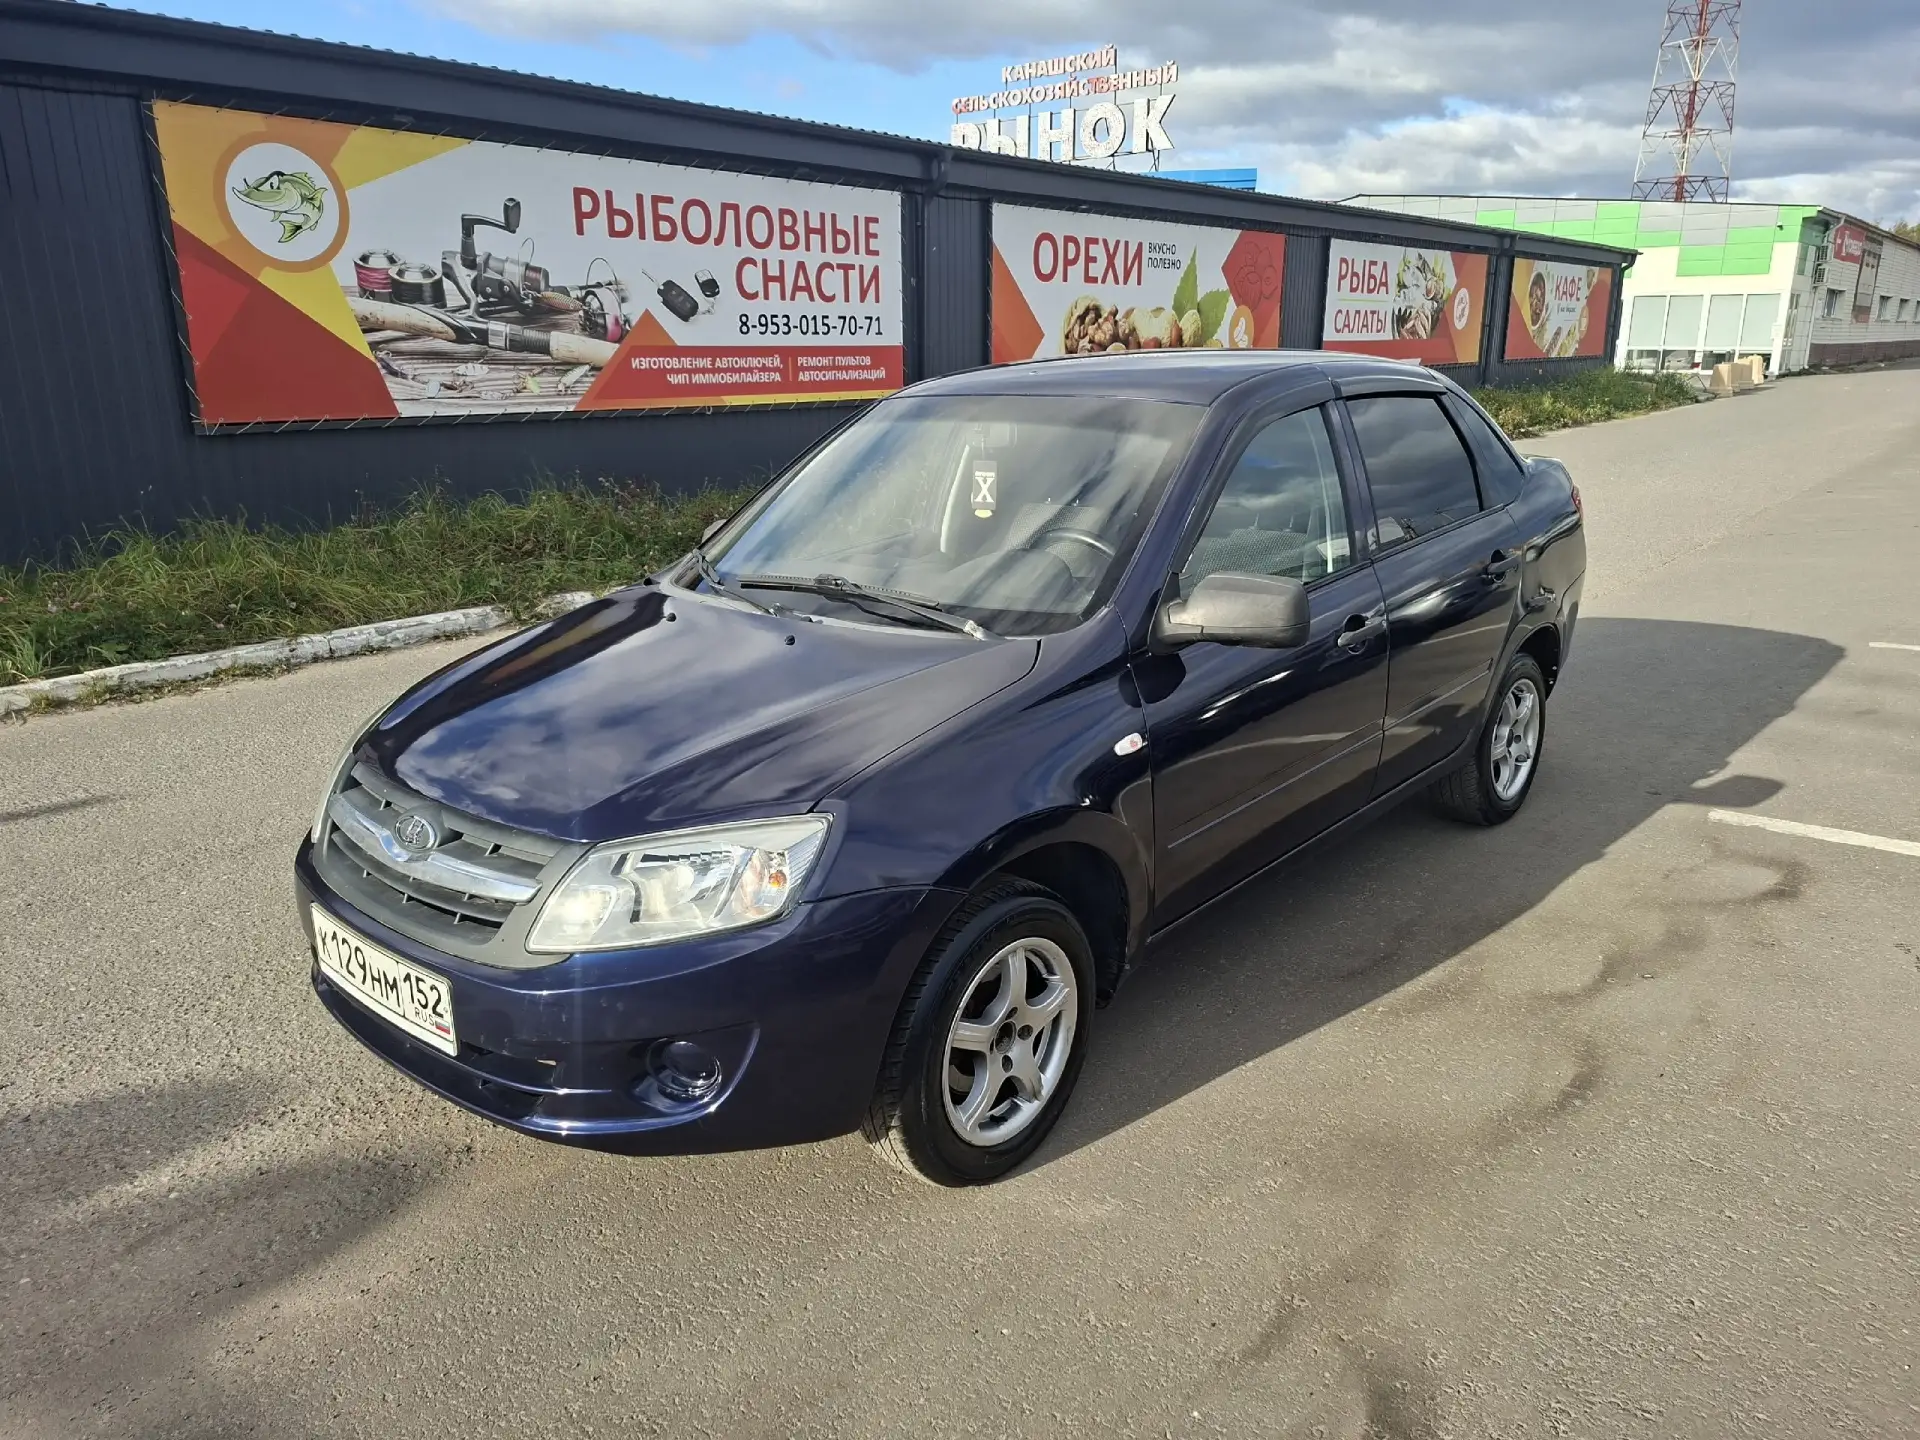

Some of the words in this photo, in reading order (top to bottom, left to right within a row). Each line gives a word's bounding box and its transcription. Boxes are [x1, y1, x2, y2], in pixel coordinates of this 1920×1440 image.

[1001, 44, 1118, 83] КАНАШСКИЙ
[951, 60, 1179, 114] СЕЛЬСКОХОЗЯЙСТВЕННЫЙ
[573, 187, 880, 256] РЫБОЛОВНЫЕ
[1033, 232, 1143, 286] ОРЕХИ
[1148, 242, 1177, 255] ВКУСНО
[1147, 257, 1181, 270] ПОЛЕЗНО
[1337, 257, 1389, 295] РЫБА
[735, 257, 880, 304] СНАСТИ
[1554, 275, 1582, 302] КАФЕ
[739, 313, 883, 336] 8-953-015-70-71
[1334, 309, 1387, 334] САЛАТЫ
[631, 357, 713, 369] ИЗГОТОВЛЕНИЕ
[715, 354, 783, 369] АВТОКЛЮЧЕЙ,
[797, 356, 834, 367] РЕМОНТ
[835, 355, 871, 366] ПУЛЬТОВ
[667, 373, 689, 384] ЧИП
[692, 369, 781, 384] ИММОБИЛАЙЗЕРА
[798, 367, 886, 382] АВТОСИГНАЛИЗАЦИЙ
[403, 972, 444, 1018] 152
[414, 1007, 435, 1026] RUS
